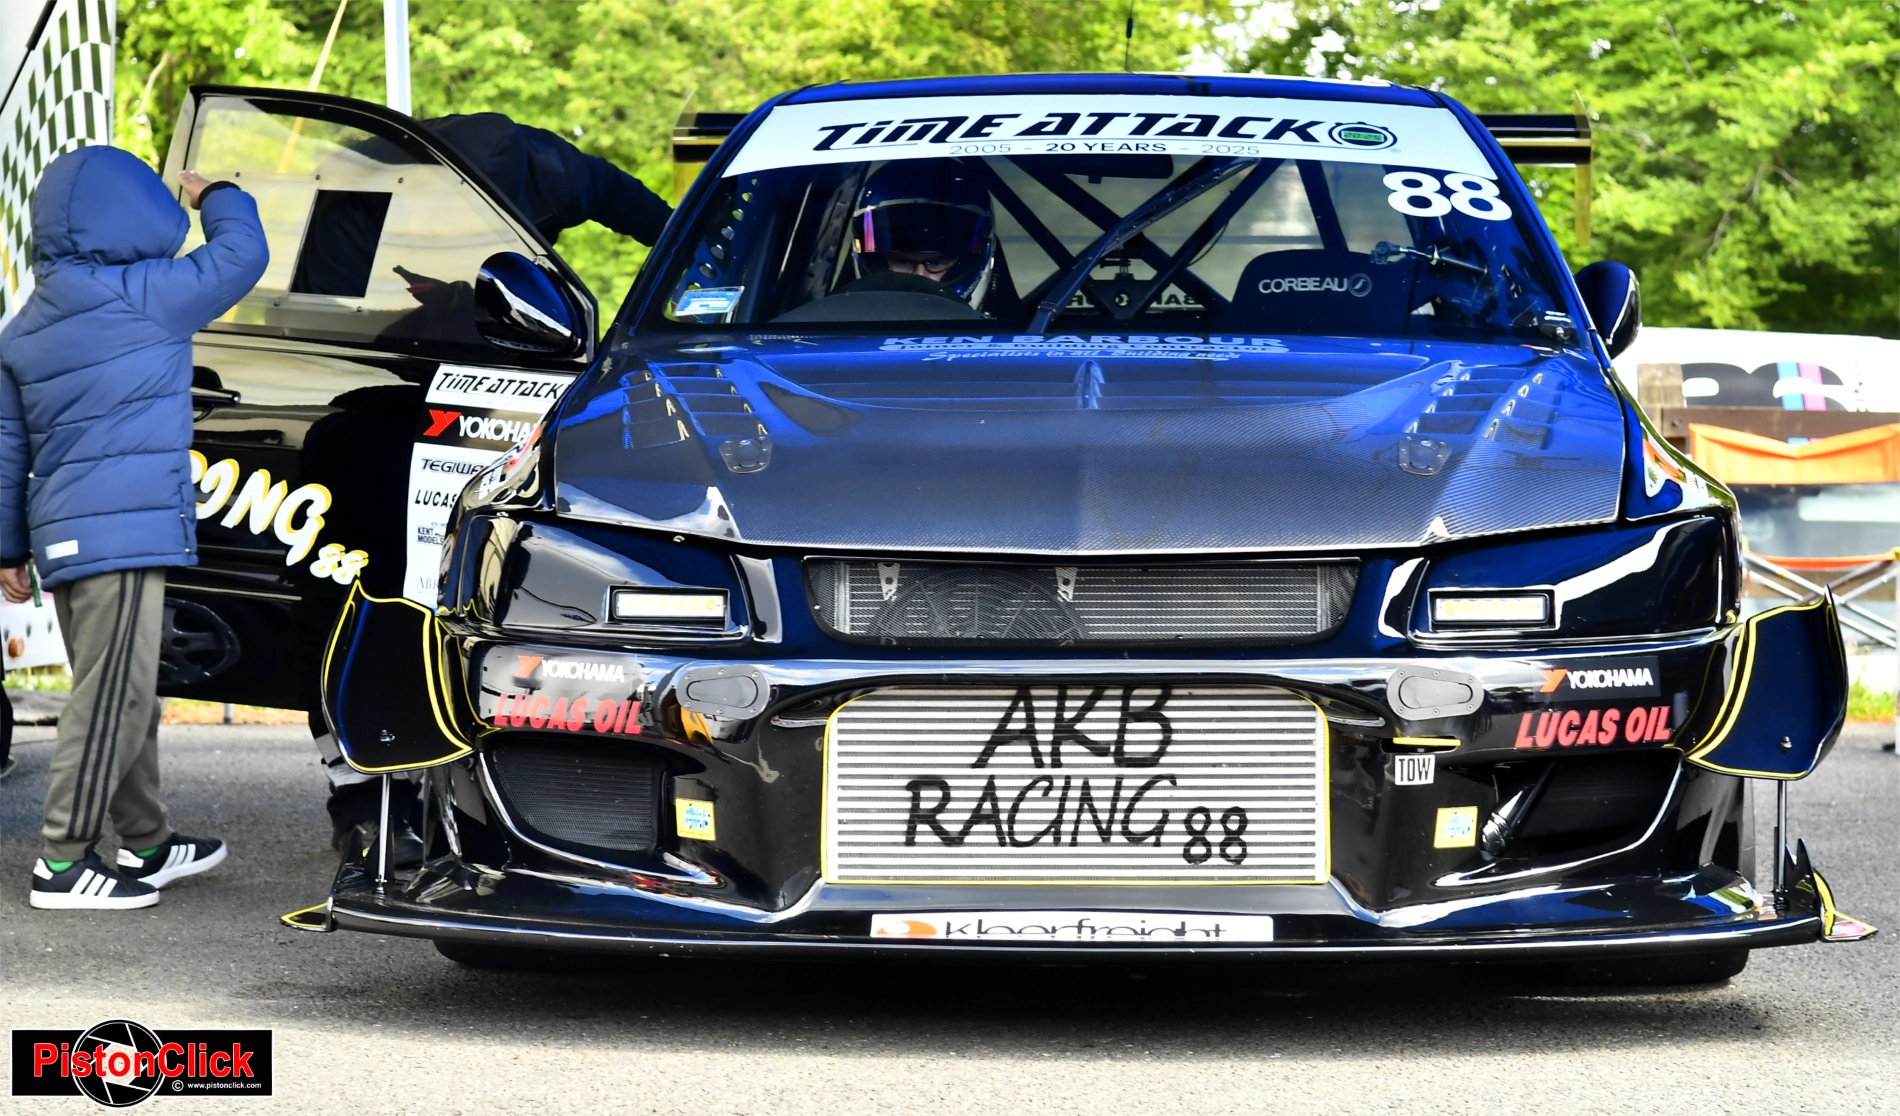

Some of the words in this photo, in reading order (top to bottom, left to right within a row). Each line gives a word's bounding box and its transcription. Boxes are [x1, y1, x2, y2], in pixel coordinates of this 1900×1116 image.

[1013, 112, 1327, 143] ATTACK
[950, 144, 1011, 155] 2005
[1045, 142, 1075, 152] 20
[1083, 142, 1167, 152] YEARS
[1201, 143, 1260, 155] 2025
[1382, 171, 1513, 221] 88
[1258, 277, 1348, 294] CORBEAU
[883, 335, 993, 345] KEN
[1012, 335, 1286, 348] BARBOUR
[484, 377, 565, 399] ATTACK
[458, 415, 538, 443] YOKOHA
[417, 526, 434, 536] KENT
[309, 543, 369, 585] 88
[541, 660, 625, 682] YOKOHAMA
[1565, 668, 1653, 689] YOKOHAMA
[494, 693, 589, 732] LUCAS
[593, 700, 642, 735] OIL
[970, 685, 1174, 769] AKB
[1515, 707, 1619, 748] LUCAS
[1624, 706, 1672, 743] OIL
[1398, 757, 1431, 782] TOW
[904, 774, 1178, 847] RACING
[1182, 805, 1249, 865] 88
